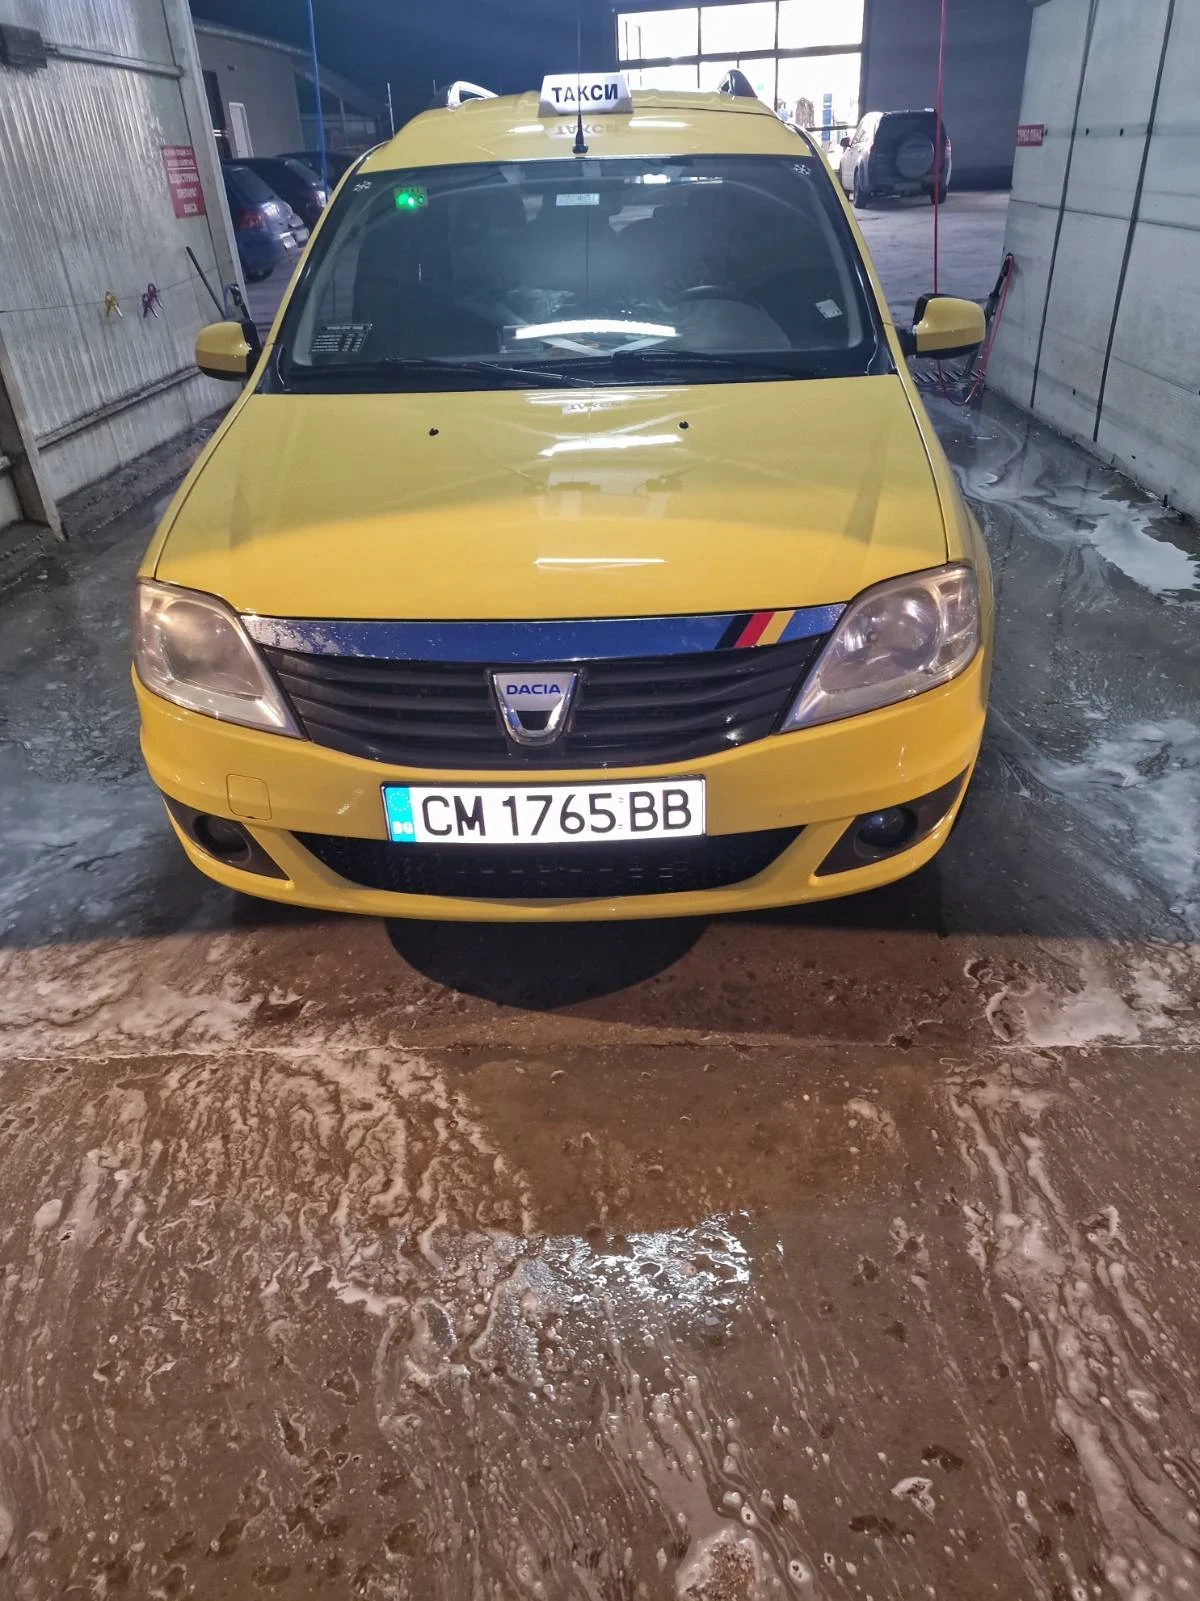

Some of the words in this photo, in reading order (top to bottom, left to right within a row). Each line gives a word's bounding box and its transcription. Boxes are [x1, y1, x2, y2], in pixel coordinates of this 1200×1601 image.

[551, 83, 619, 103] ТАКСИ
[506, 684, 561, 695] DACIA
[422, 795, 485, 837] CM
[502, 792, 617, 838] 1765
[629, 789, 692, 832] BB
[391, 820, 415, 835] BG
